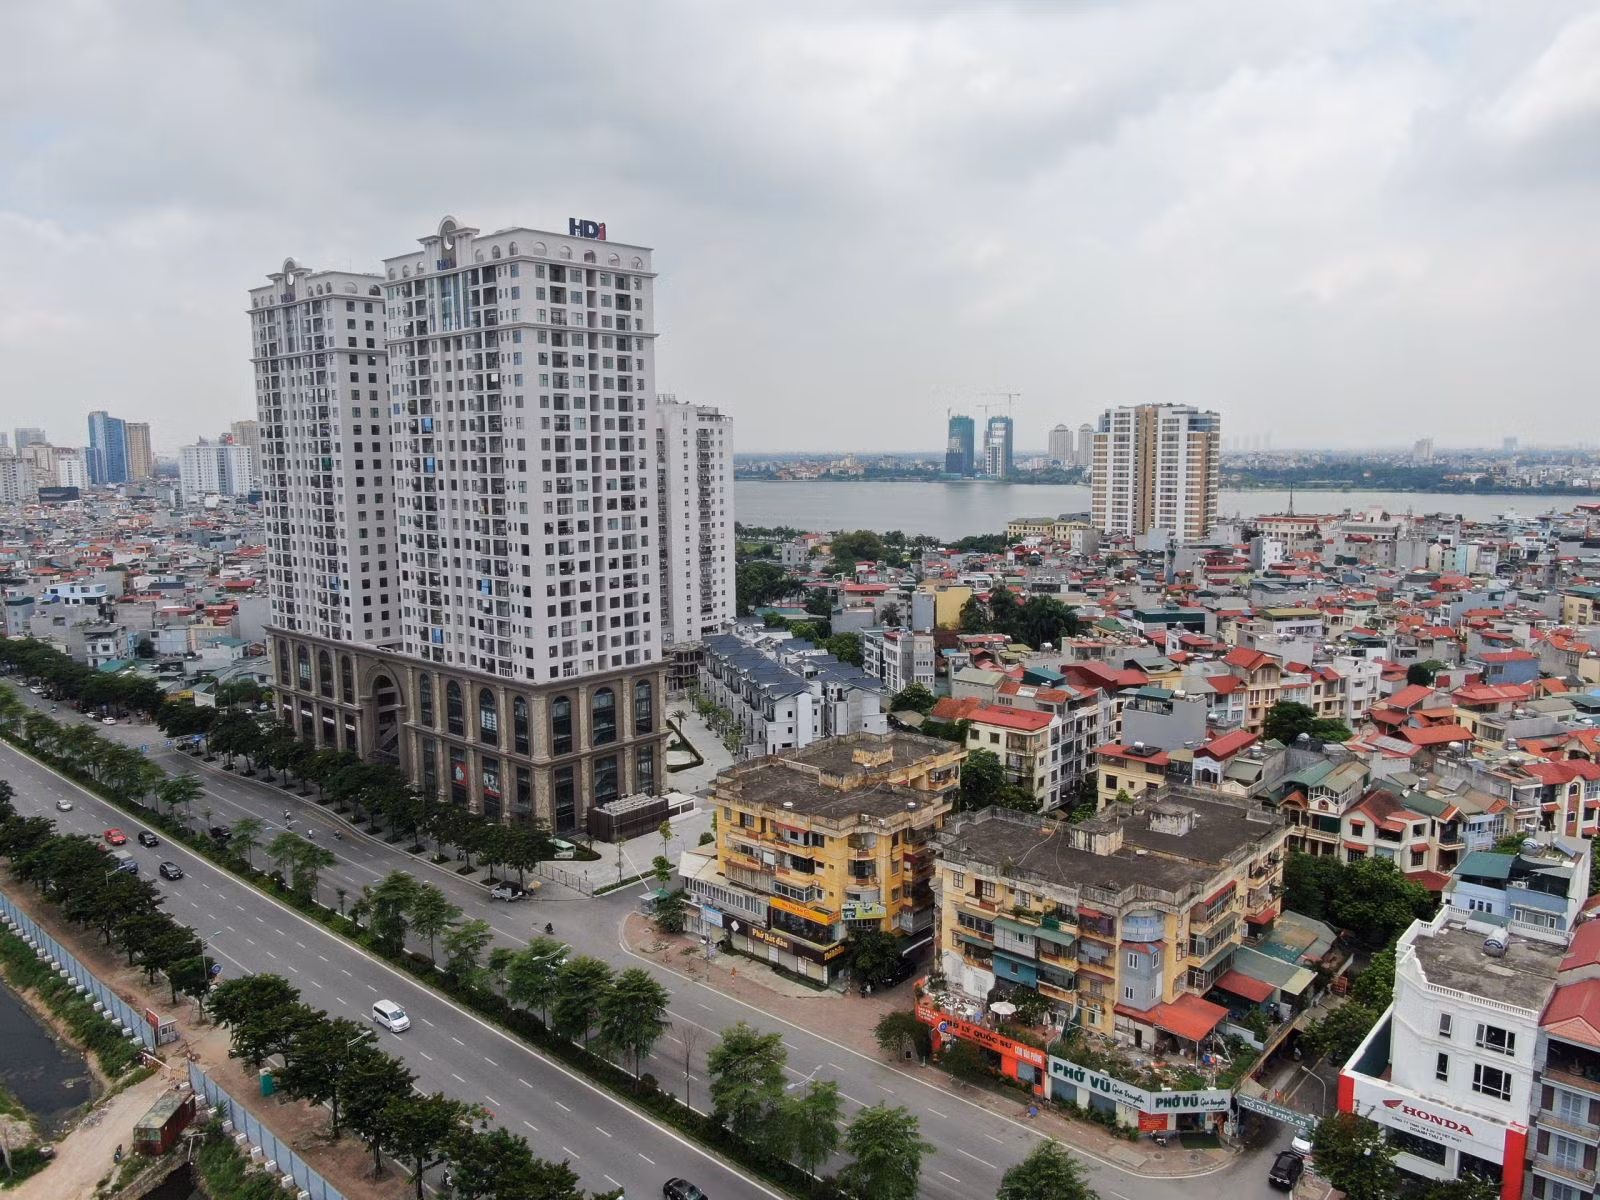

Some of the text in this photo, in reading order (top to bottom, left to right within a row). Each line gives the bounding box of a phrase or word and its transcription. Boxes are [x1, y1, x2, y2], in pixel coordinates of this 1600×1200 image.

[1053, 1062, 1085, 1083] PHỞ
[1090, 1076, 1111, 1093] VŨ
[1155, 1094, 1181, 1108] PHỞ
[1182, 1093, 1198, 1107] VŨ
[1256, 1104, 1273, 1115] DÂN
[1402, 1104, 1474, 1137] HONDA
